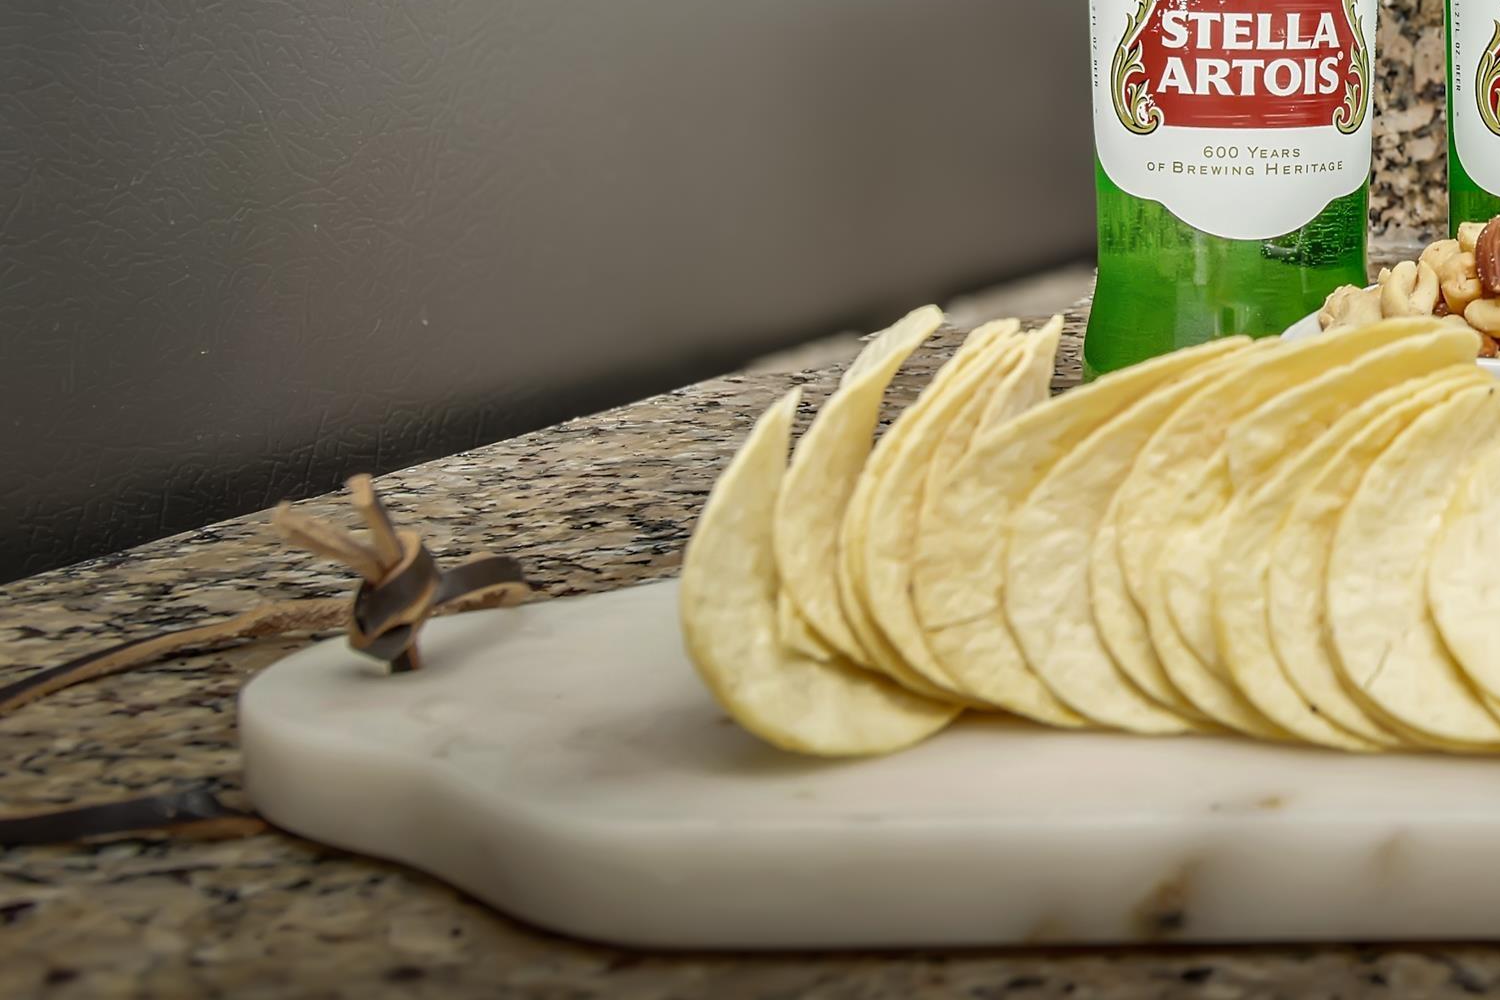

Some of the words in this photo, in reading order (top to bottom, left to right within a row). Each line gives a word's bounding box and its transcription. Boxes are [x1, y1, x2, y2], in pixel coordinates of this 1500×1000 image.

[1161, 10, 1340, 50] STELLA
[1156, 56, 1340, 96] ARTOIS
[1203, 145, 1239, 159] 600
[1247, 146, 1301, 158] YEARS
[1147, 161, 1165, 172] OF
[1172, 161, 1255, 176] BREWING
[1265, 160, 1343, 175] HERITAGE
